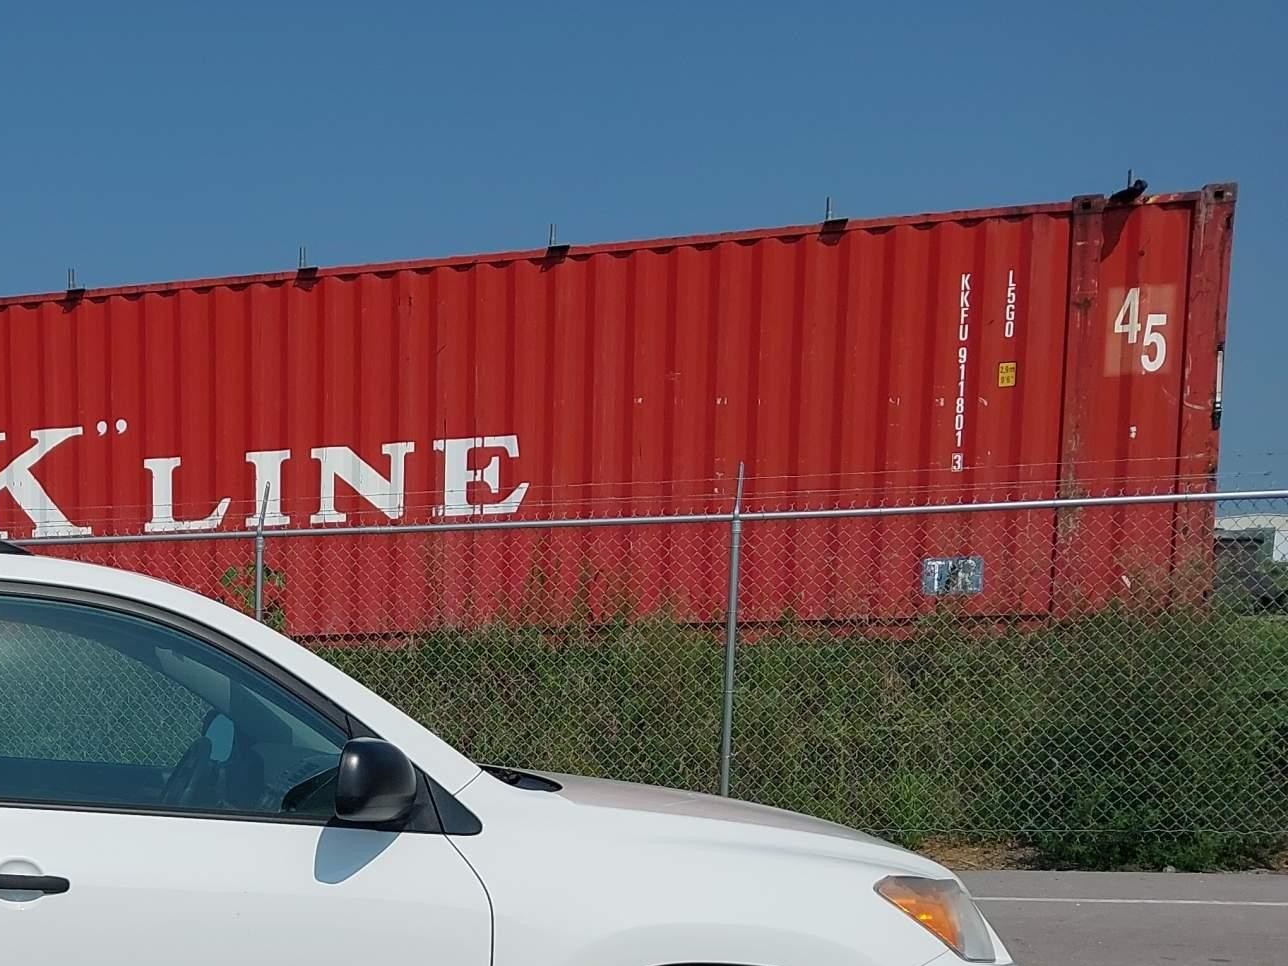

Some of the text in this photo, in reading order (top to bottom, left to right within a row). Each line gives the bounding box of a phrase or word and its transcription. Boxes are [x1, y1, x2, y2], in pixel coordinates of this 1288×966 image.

[952, 273, 971, 471] KKFU 911801 3
[1114, 287, 1167, 372] 45
[143, 434, 530, 533] LINE
